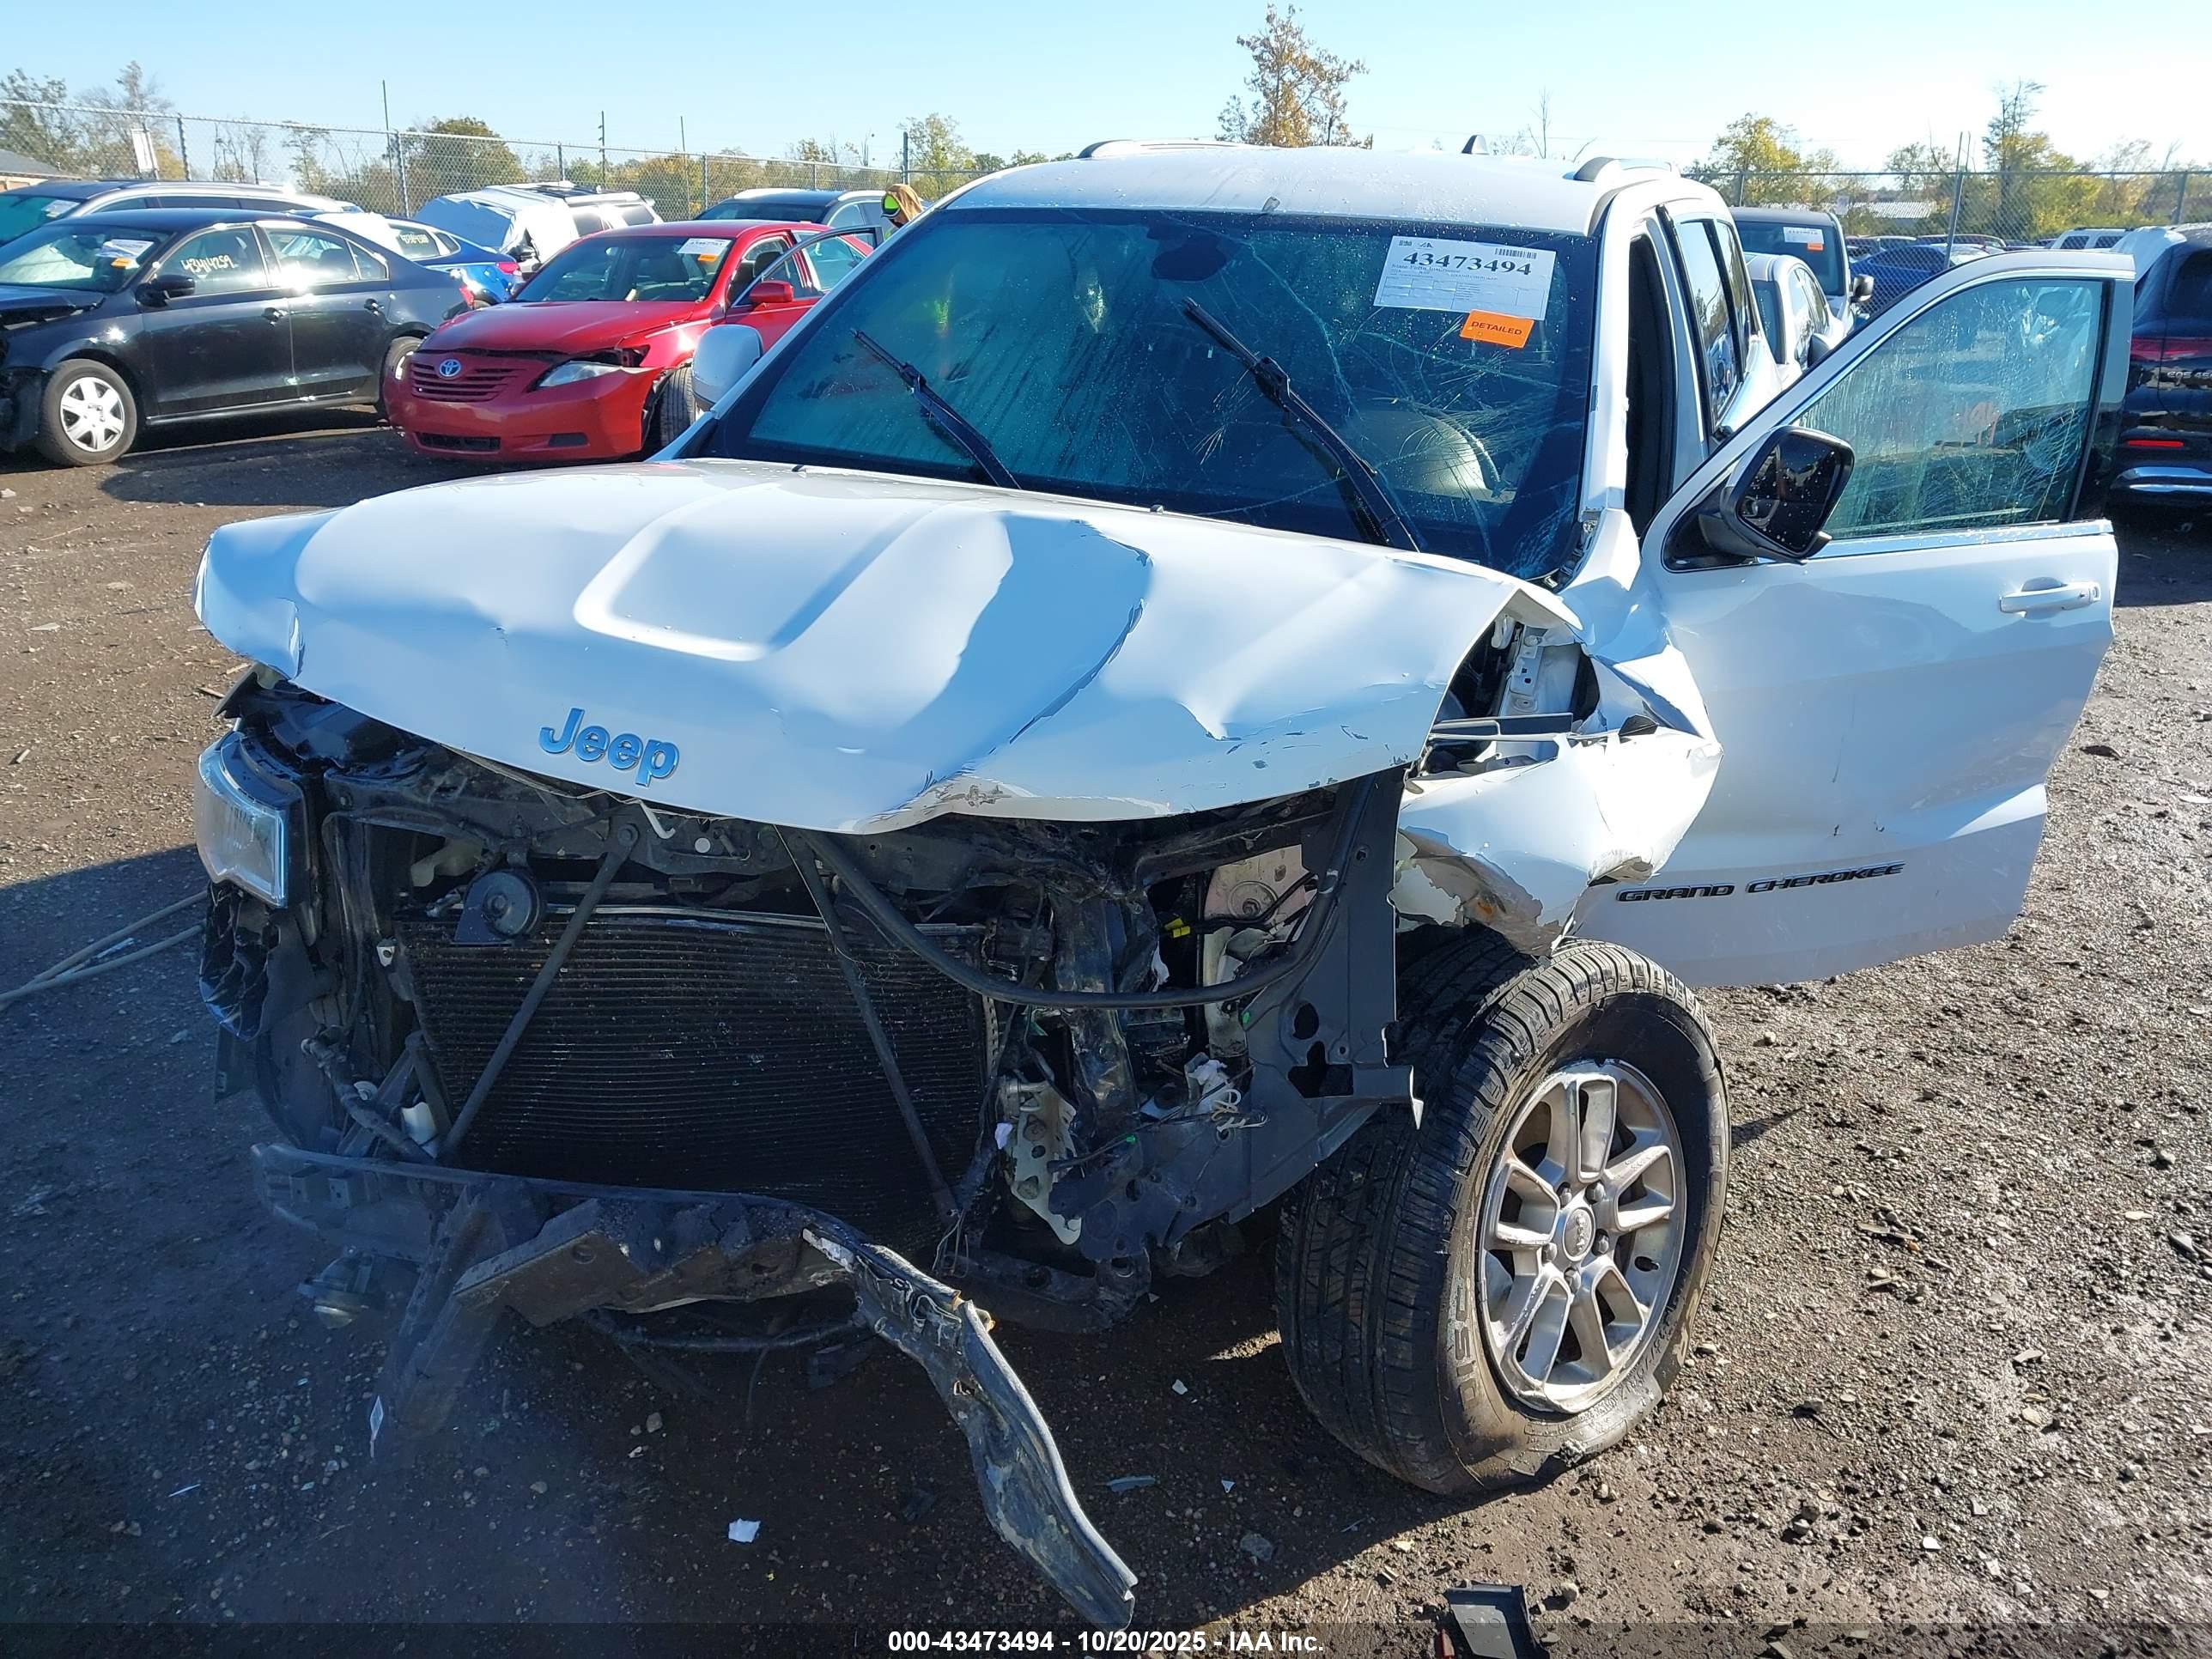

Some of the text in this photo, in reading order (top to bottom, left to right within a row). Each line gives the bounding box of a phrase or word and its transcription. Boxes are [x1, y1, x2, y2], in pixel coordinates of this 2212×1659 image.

[1403, 252, 1532, 276] 43473494
[1471, 320, 1522, 336] DETAILED
[538, 708, 680, 787] Jeep
[1616, 860, 1907, 902] GRAND CHEROKEE
